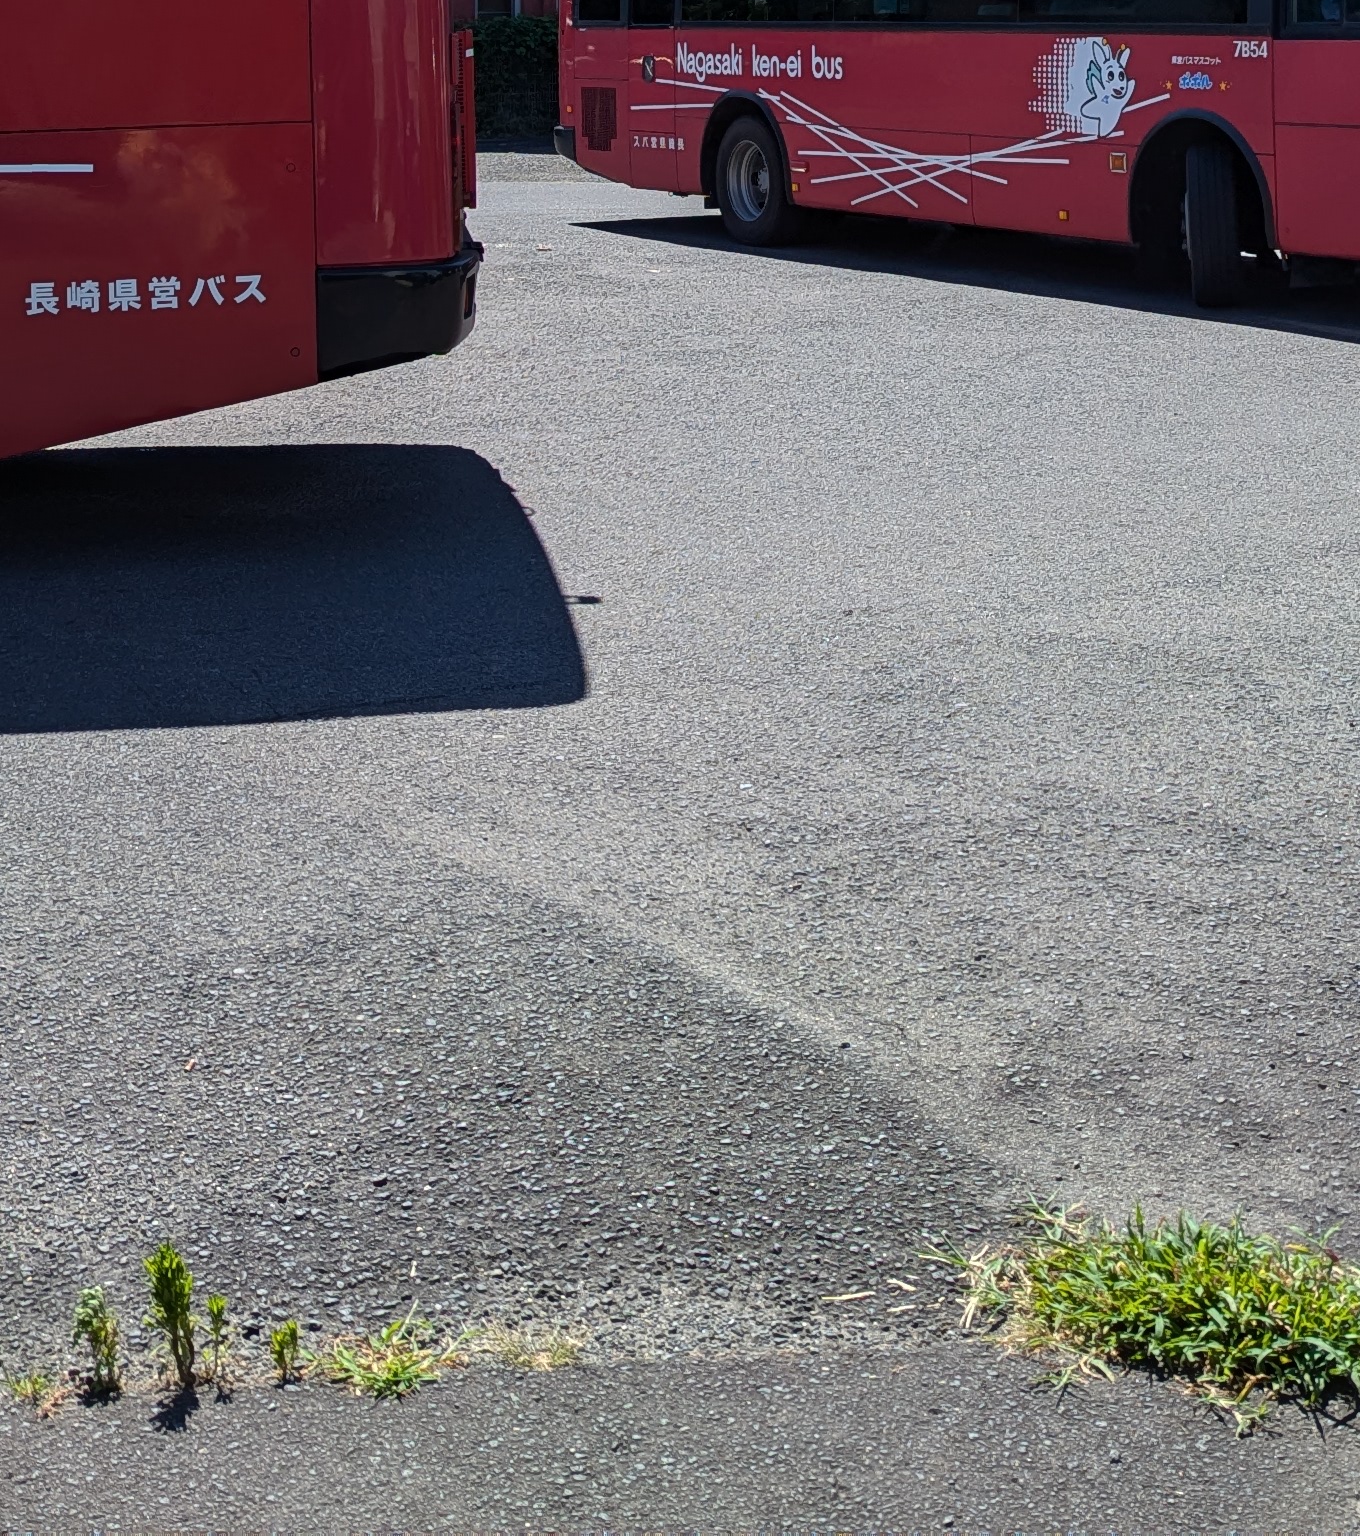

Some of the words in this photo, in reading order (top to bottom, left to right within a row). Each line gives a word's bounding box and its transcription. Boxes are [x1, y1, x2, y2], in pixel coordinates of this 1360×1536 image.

[677, 41, 742, 82] Nagasaki
[752, 44, 802, 78] ken-ei
[812, 44, 843, 79] bus
[1233, 40, 1268, 58] 7B54
[25, 275, 267, 315] 長崎県営バス
